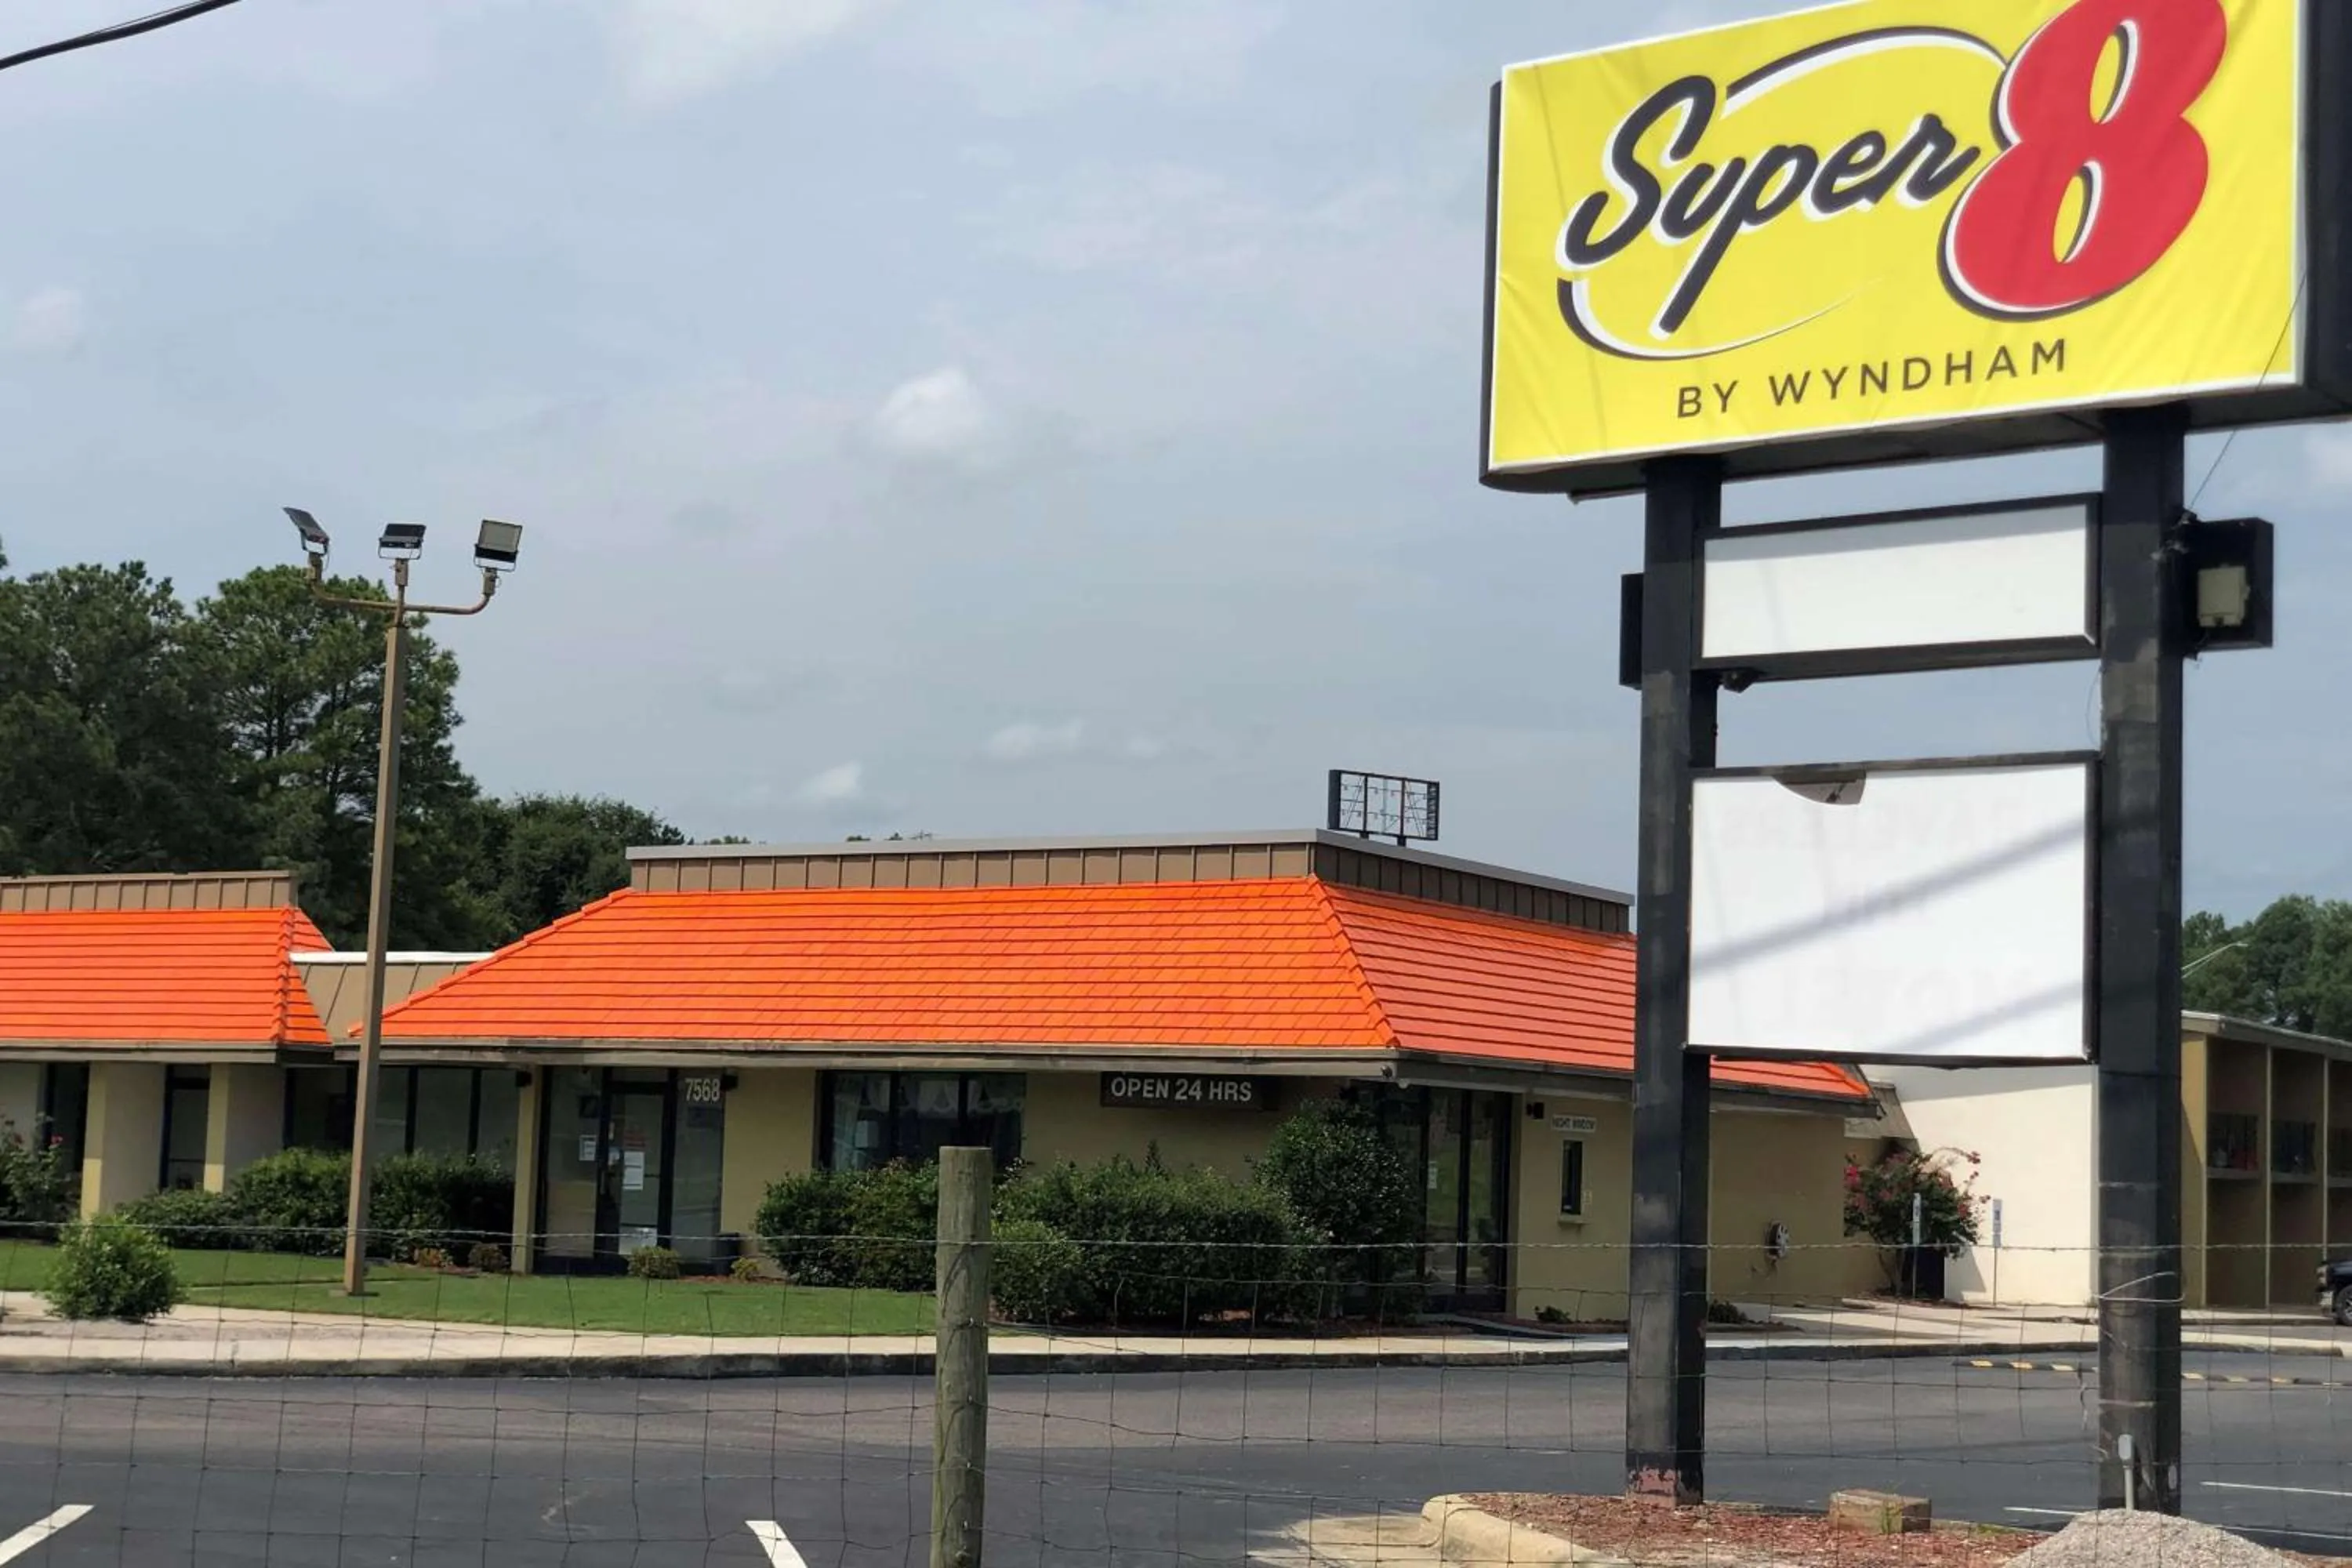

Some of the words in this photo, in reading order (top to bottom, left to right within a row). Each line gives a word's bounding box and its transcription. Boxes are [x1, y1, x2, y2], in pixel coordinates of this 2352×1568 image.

[1556, 73, 1980, 339] Super
[1938, 0, 2228, 323] 8
[1677, 379, 1739, 418] BY
[1768, 338, 2067, 406] WYNDHAM
[684, 1078, 720, 1102] 7568
[1111, 1077, 1169, 1098] OPEN
[1174, 1078, 1202, 1101] 24
[1209, 1081, 1252, 1102] HRS
